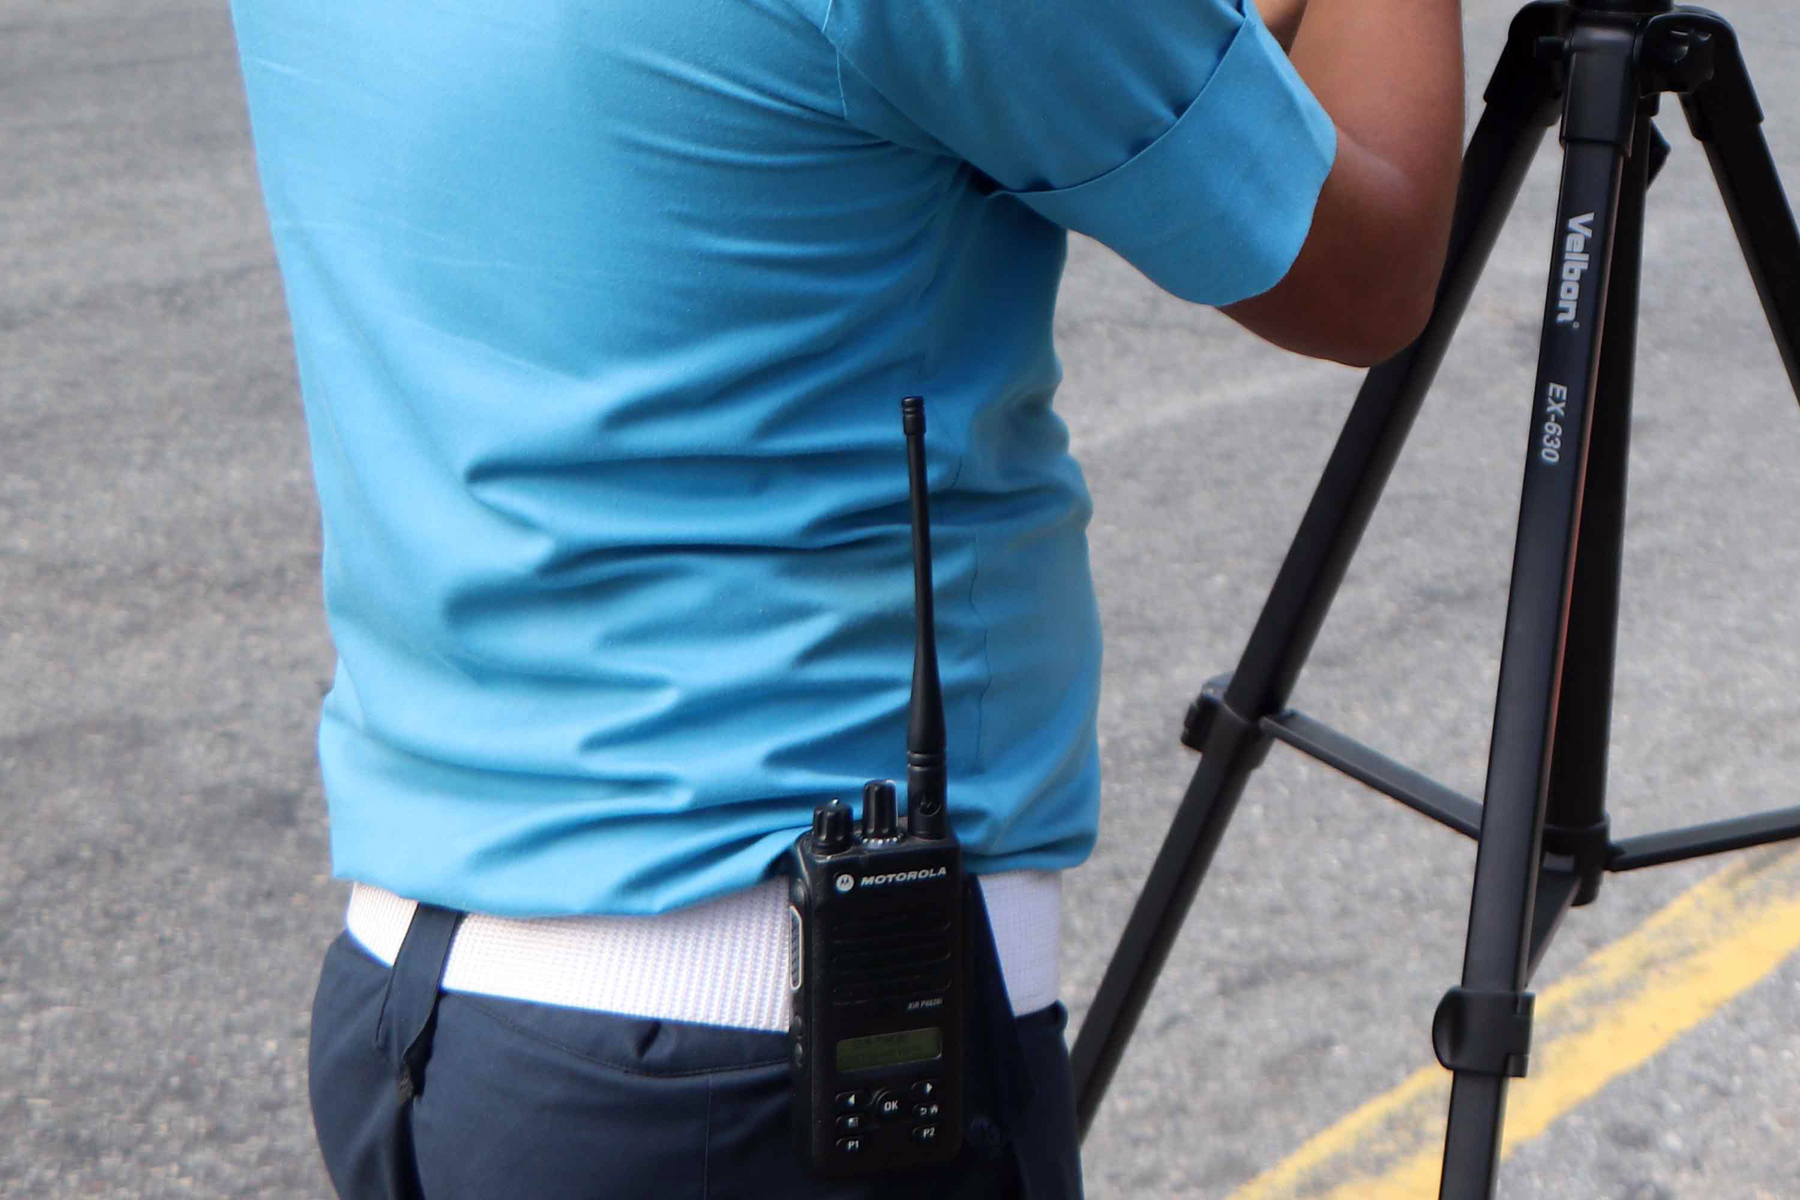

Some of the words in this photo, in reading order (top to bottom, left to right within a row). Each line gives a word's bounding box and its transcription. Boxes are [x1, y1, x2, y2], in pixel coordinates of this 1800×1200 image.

[1556, 211, 1595, 324] Velbon
[1541, 382, 1567, 464] EX-630
[860, 866, 947, 887] MOTOROLA
[883, 1100, 899, 1112] OK
[923, 1127, 936, 1139] P2
[848, 1140, 859, 1151] P1
